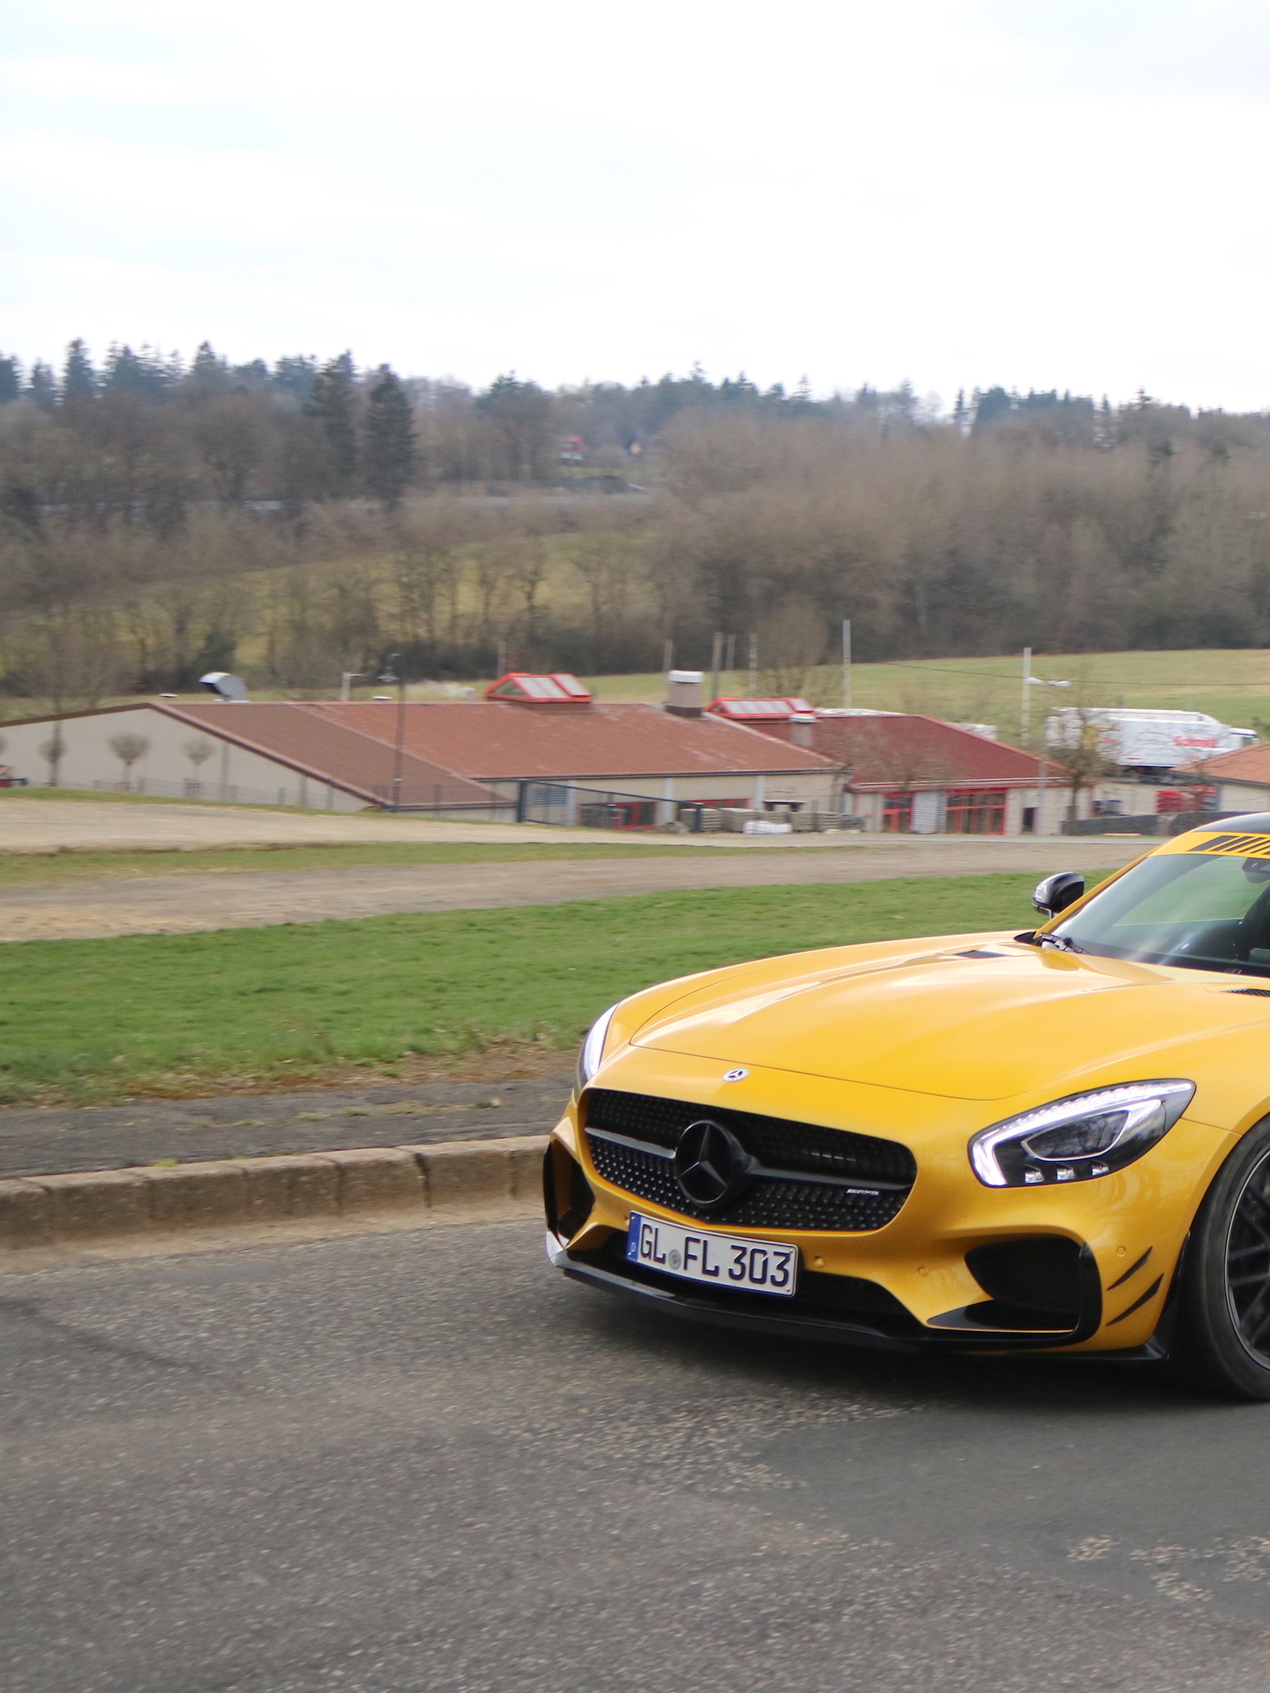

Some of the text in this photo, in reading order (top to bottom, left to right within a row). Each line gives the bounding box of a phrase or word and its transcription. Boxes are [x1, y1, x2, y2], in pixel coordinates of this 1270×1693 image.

[640, 1223, 790, 1287] GL FL 303
